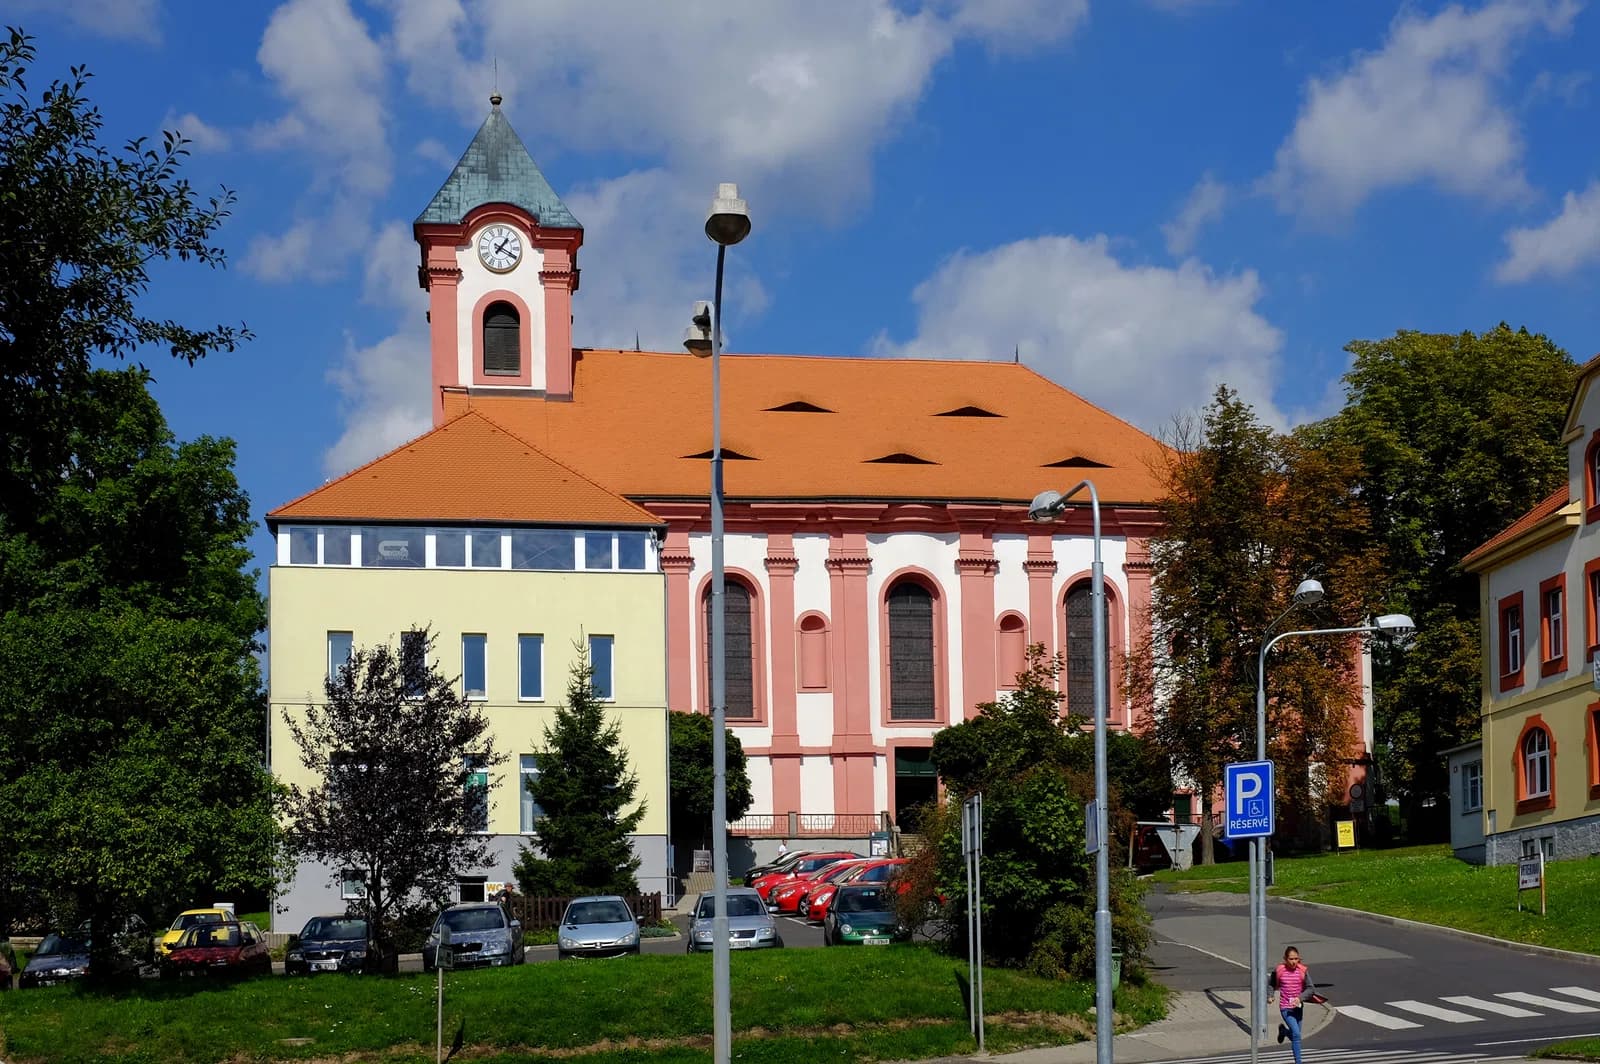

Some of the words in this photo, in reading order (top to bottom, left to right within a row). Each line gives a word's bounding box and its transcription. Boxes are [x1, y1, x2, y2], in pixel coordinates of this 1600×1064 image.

[1236, 773, 1262, 814] P
[1230, 816, 1269, 829] RÉSERVÉ
[486, 883, 503, 892] WC
